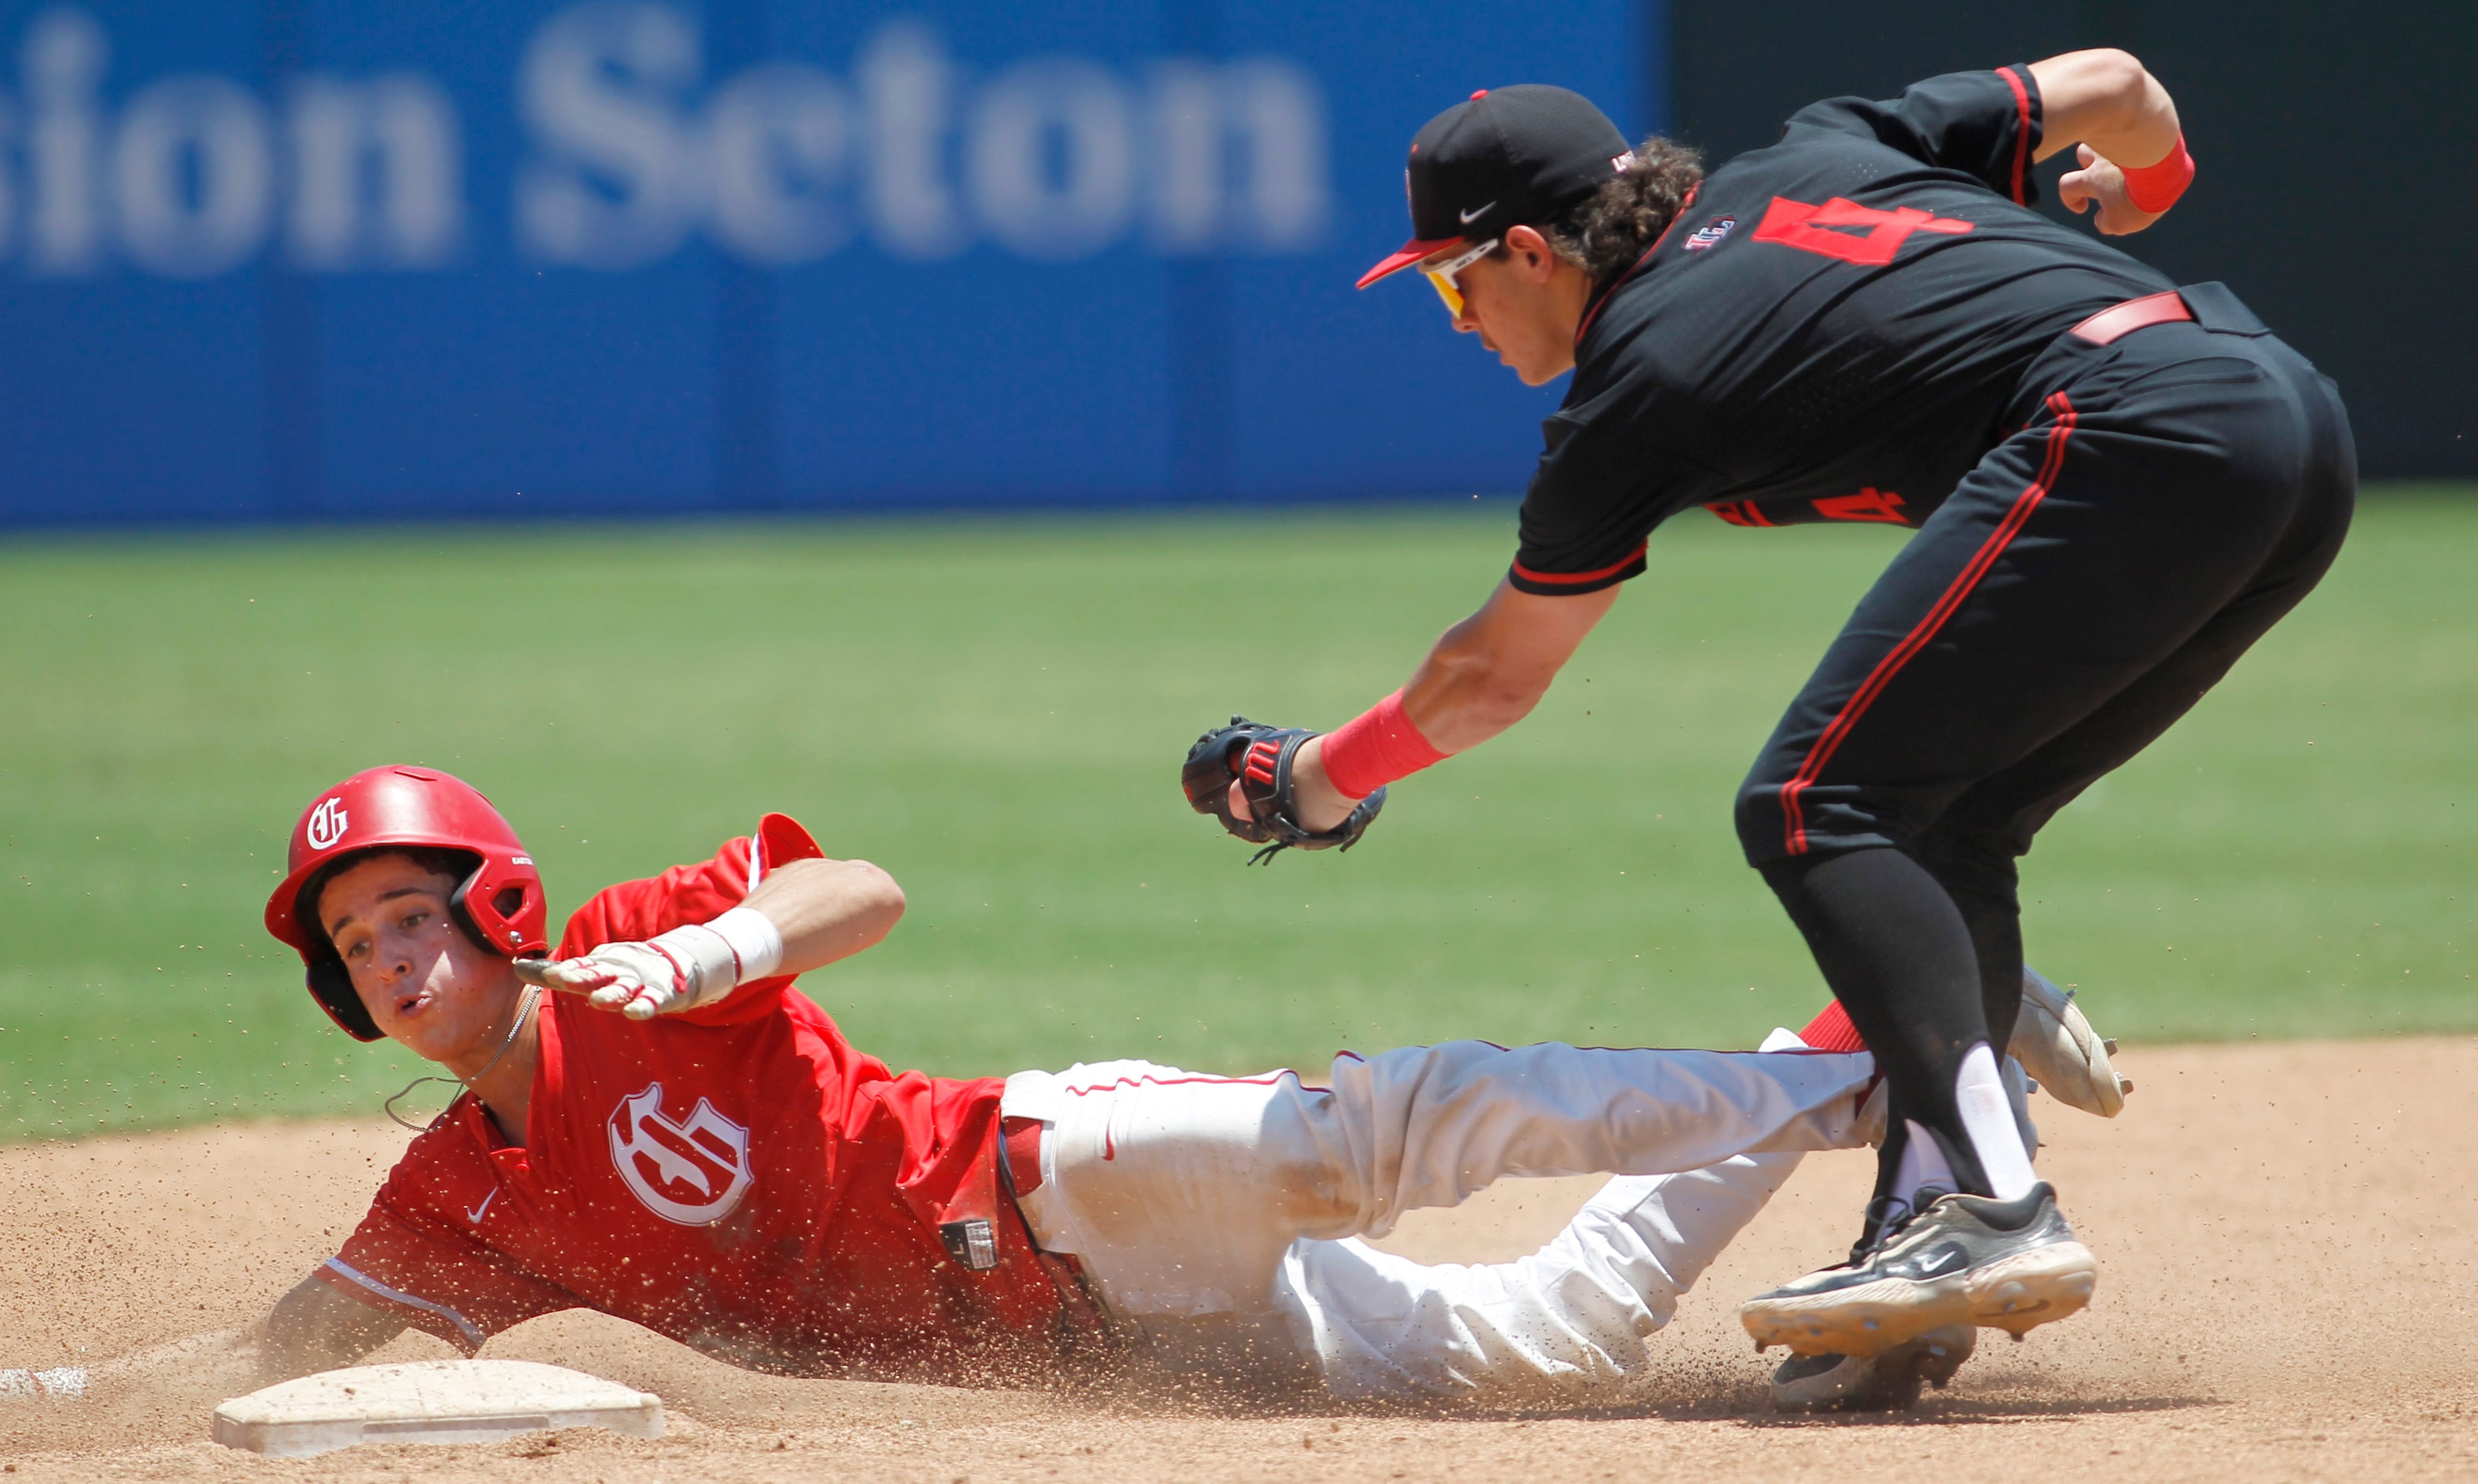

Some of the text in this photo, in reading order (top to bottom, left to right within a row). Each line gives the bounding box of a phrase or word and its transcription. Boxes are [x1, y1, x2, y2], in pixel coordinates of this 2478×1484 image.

[0, 13, 465, 273] ion
[1752, 196, 1975, 266] 4
[306, 796, 349, 851] G
[606, 1080, 755, 1226] G
